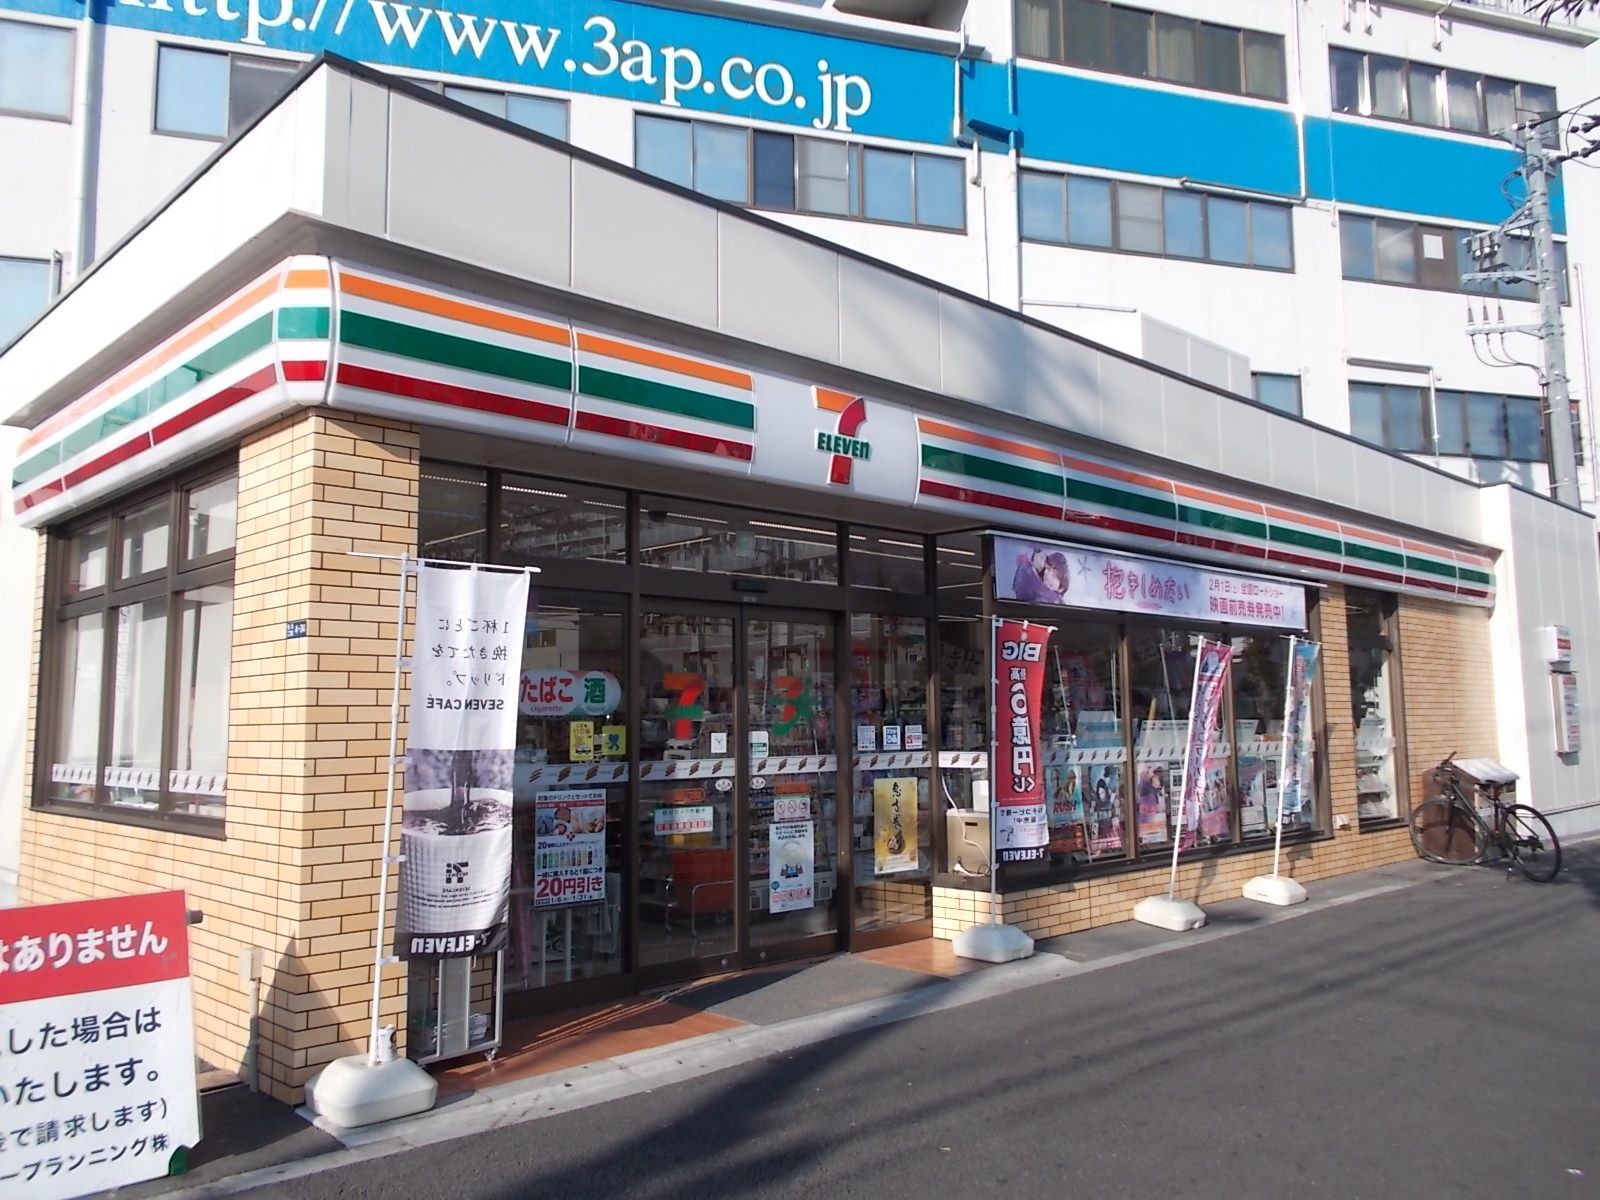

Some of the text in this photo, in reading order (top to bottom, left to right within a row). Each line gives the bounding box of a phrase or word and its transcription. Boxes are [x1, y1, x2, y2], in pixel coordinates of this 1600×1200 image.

[1102, 560, 1190, 604] 抱きしめたい
[520, 675, 574, 703] たばこ
[584, 677, 606, 704] 酒
[536, 876, 604, 899] 20円引き
[0, 1006, 162, 1056] した場合は
